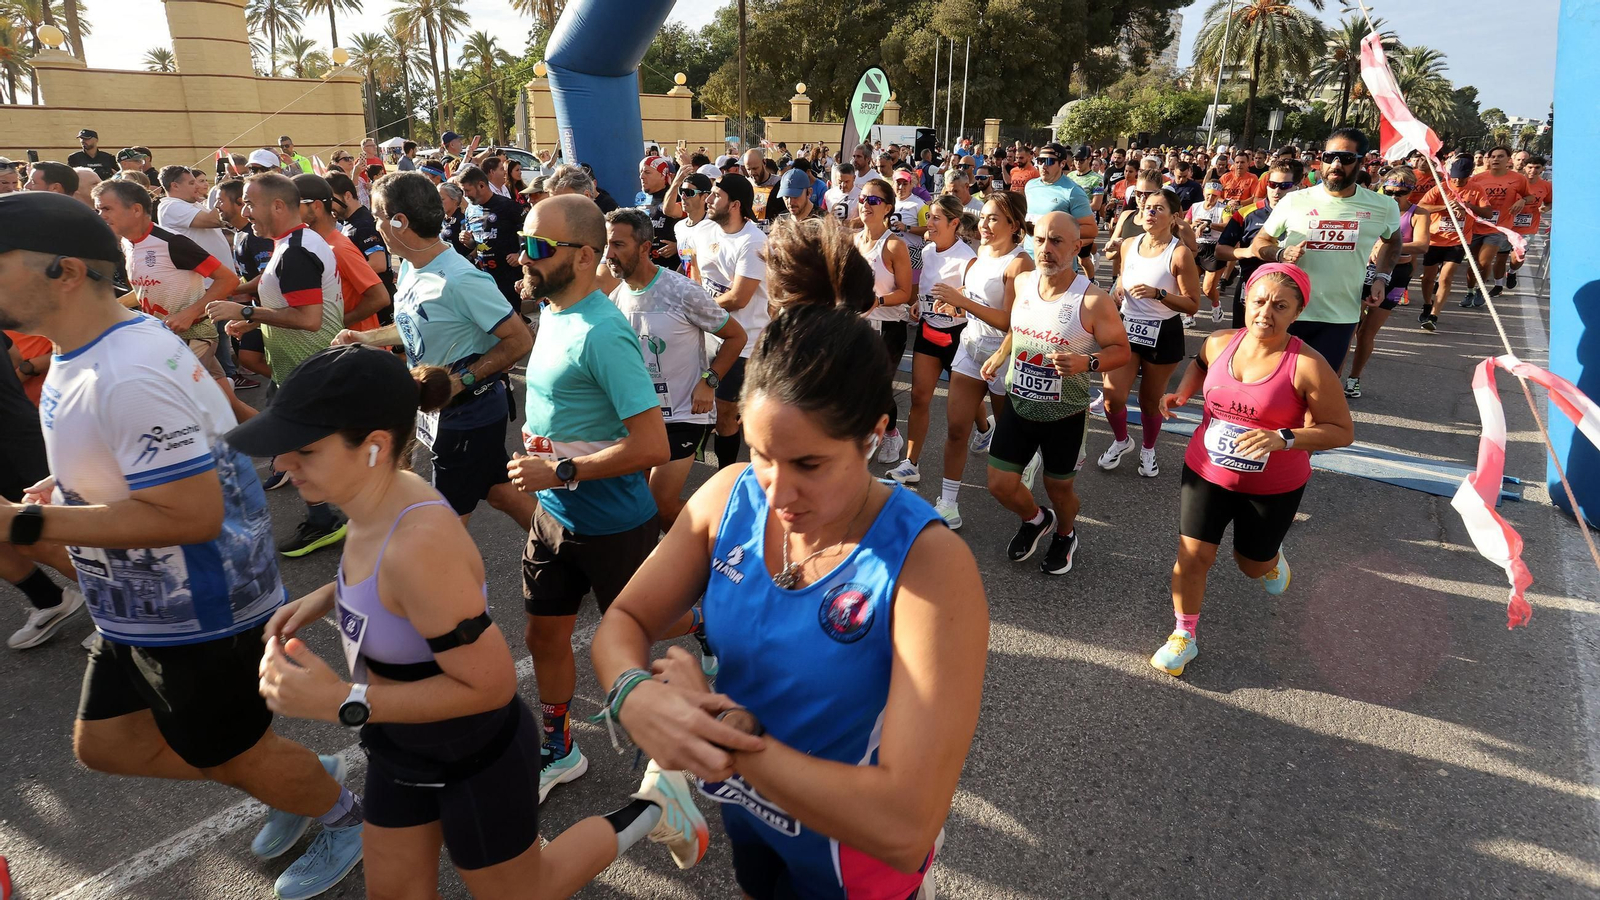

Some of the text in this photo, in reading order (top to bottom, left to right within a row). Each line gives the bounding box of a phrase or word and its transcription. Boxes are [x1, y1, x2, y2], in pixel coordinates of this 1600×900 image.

[1320, 230, 1345, 241] 196
[1013, 325, 1070, 346] maratón
[1130, 324, 1148, 336] 686
[1019, 373, 1053, 392] 1057
[1220, 459, 1260, 471] Mizuno
[712, 557, 745, 584] VIATOR
